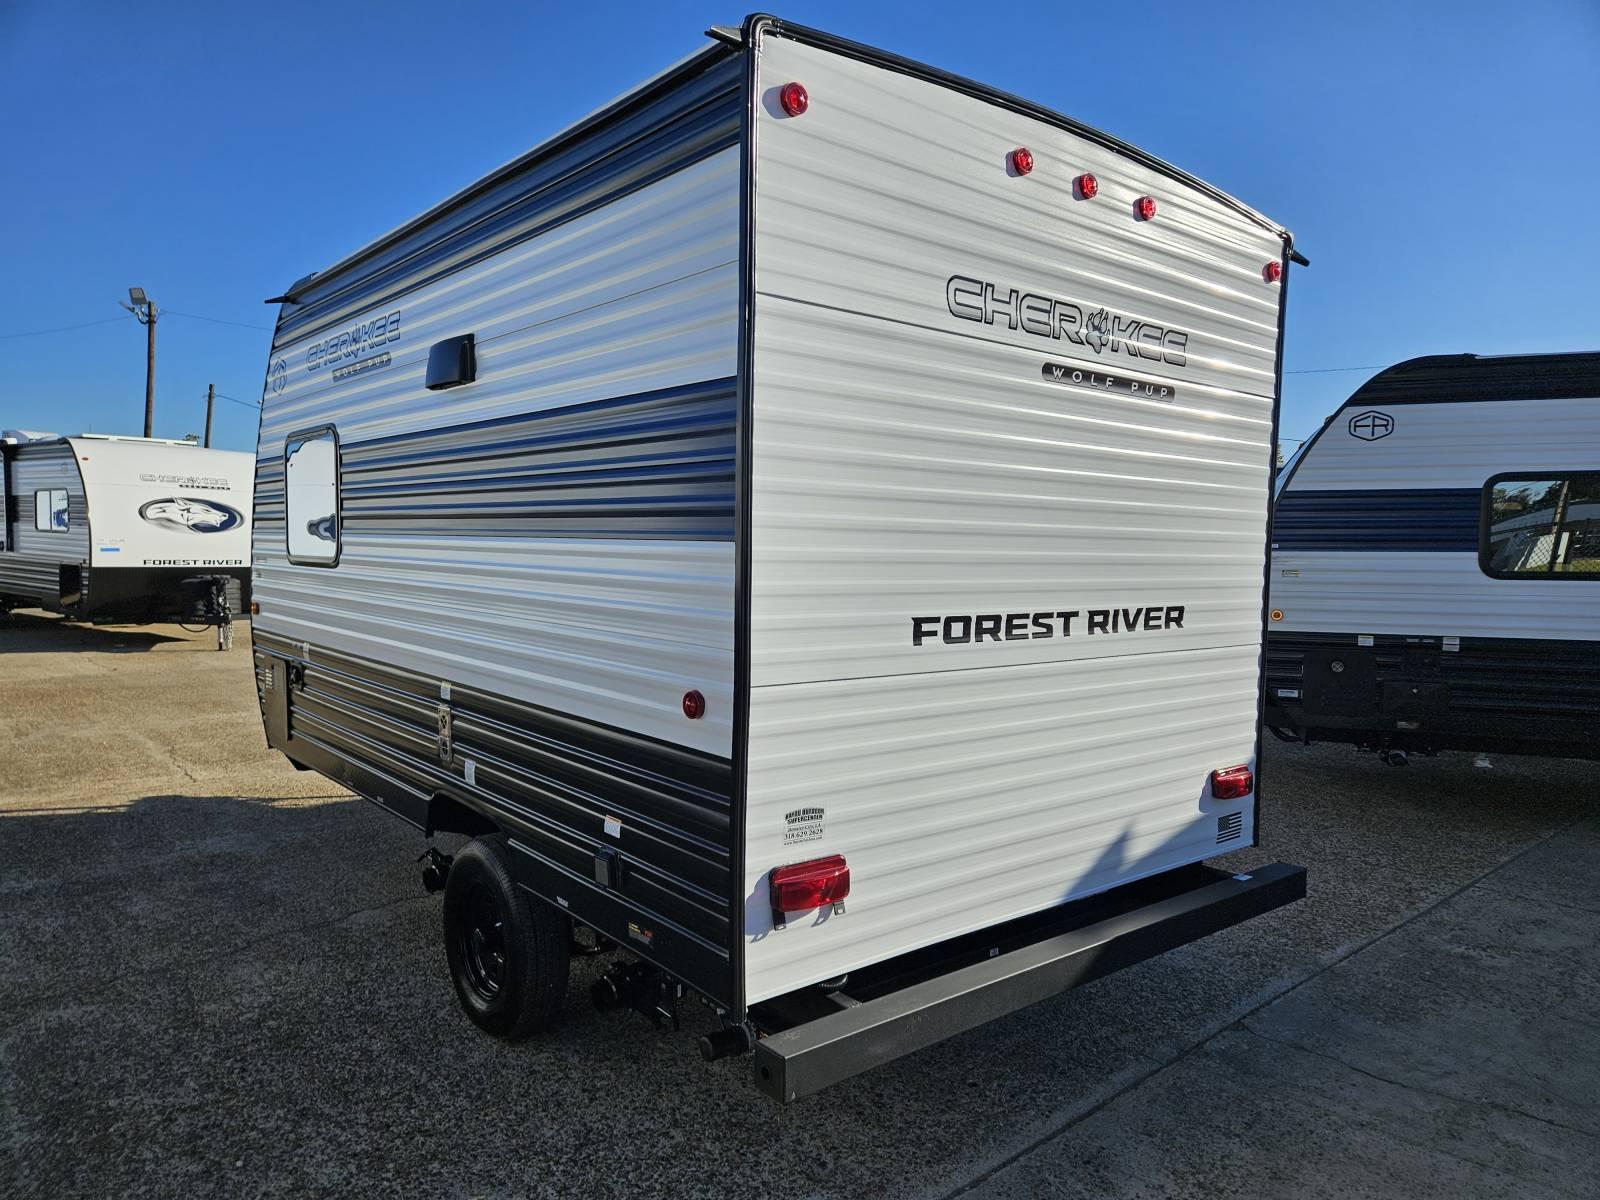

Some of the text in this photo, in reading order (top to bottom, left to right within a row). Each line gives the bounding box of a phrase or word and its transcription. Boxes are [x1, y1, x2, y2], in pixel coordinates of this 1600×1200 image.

[946, 274, 1189, 367] CHEROKEE
[1052, 366, 1168, 398] WOLF PUP
[911, 605, 1186, 646] FOREST RIVER
